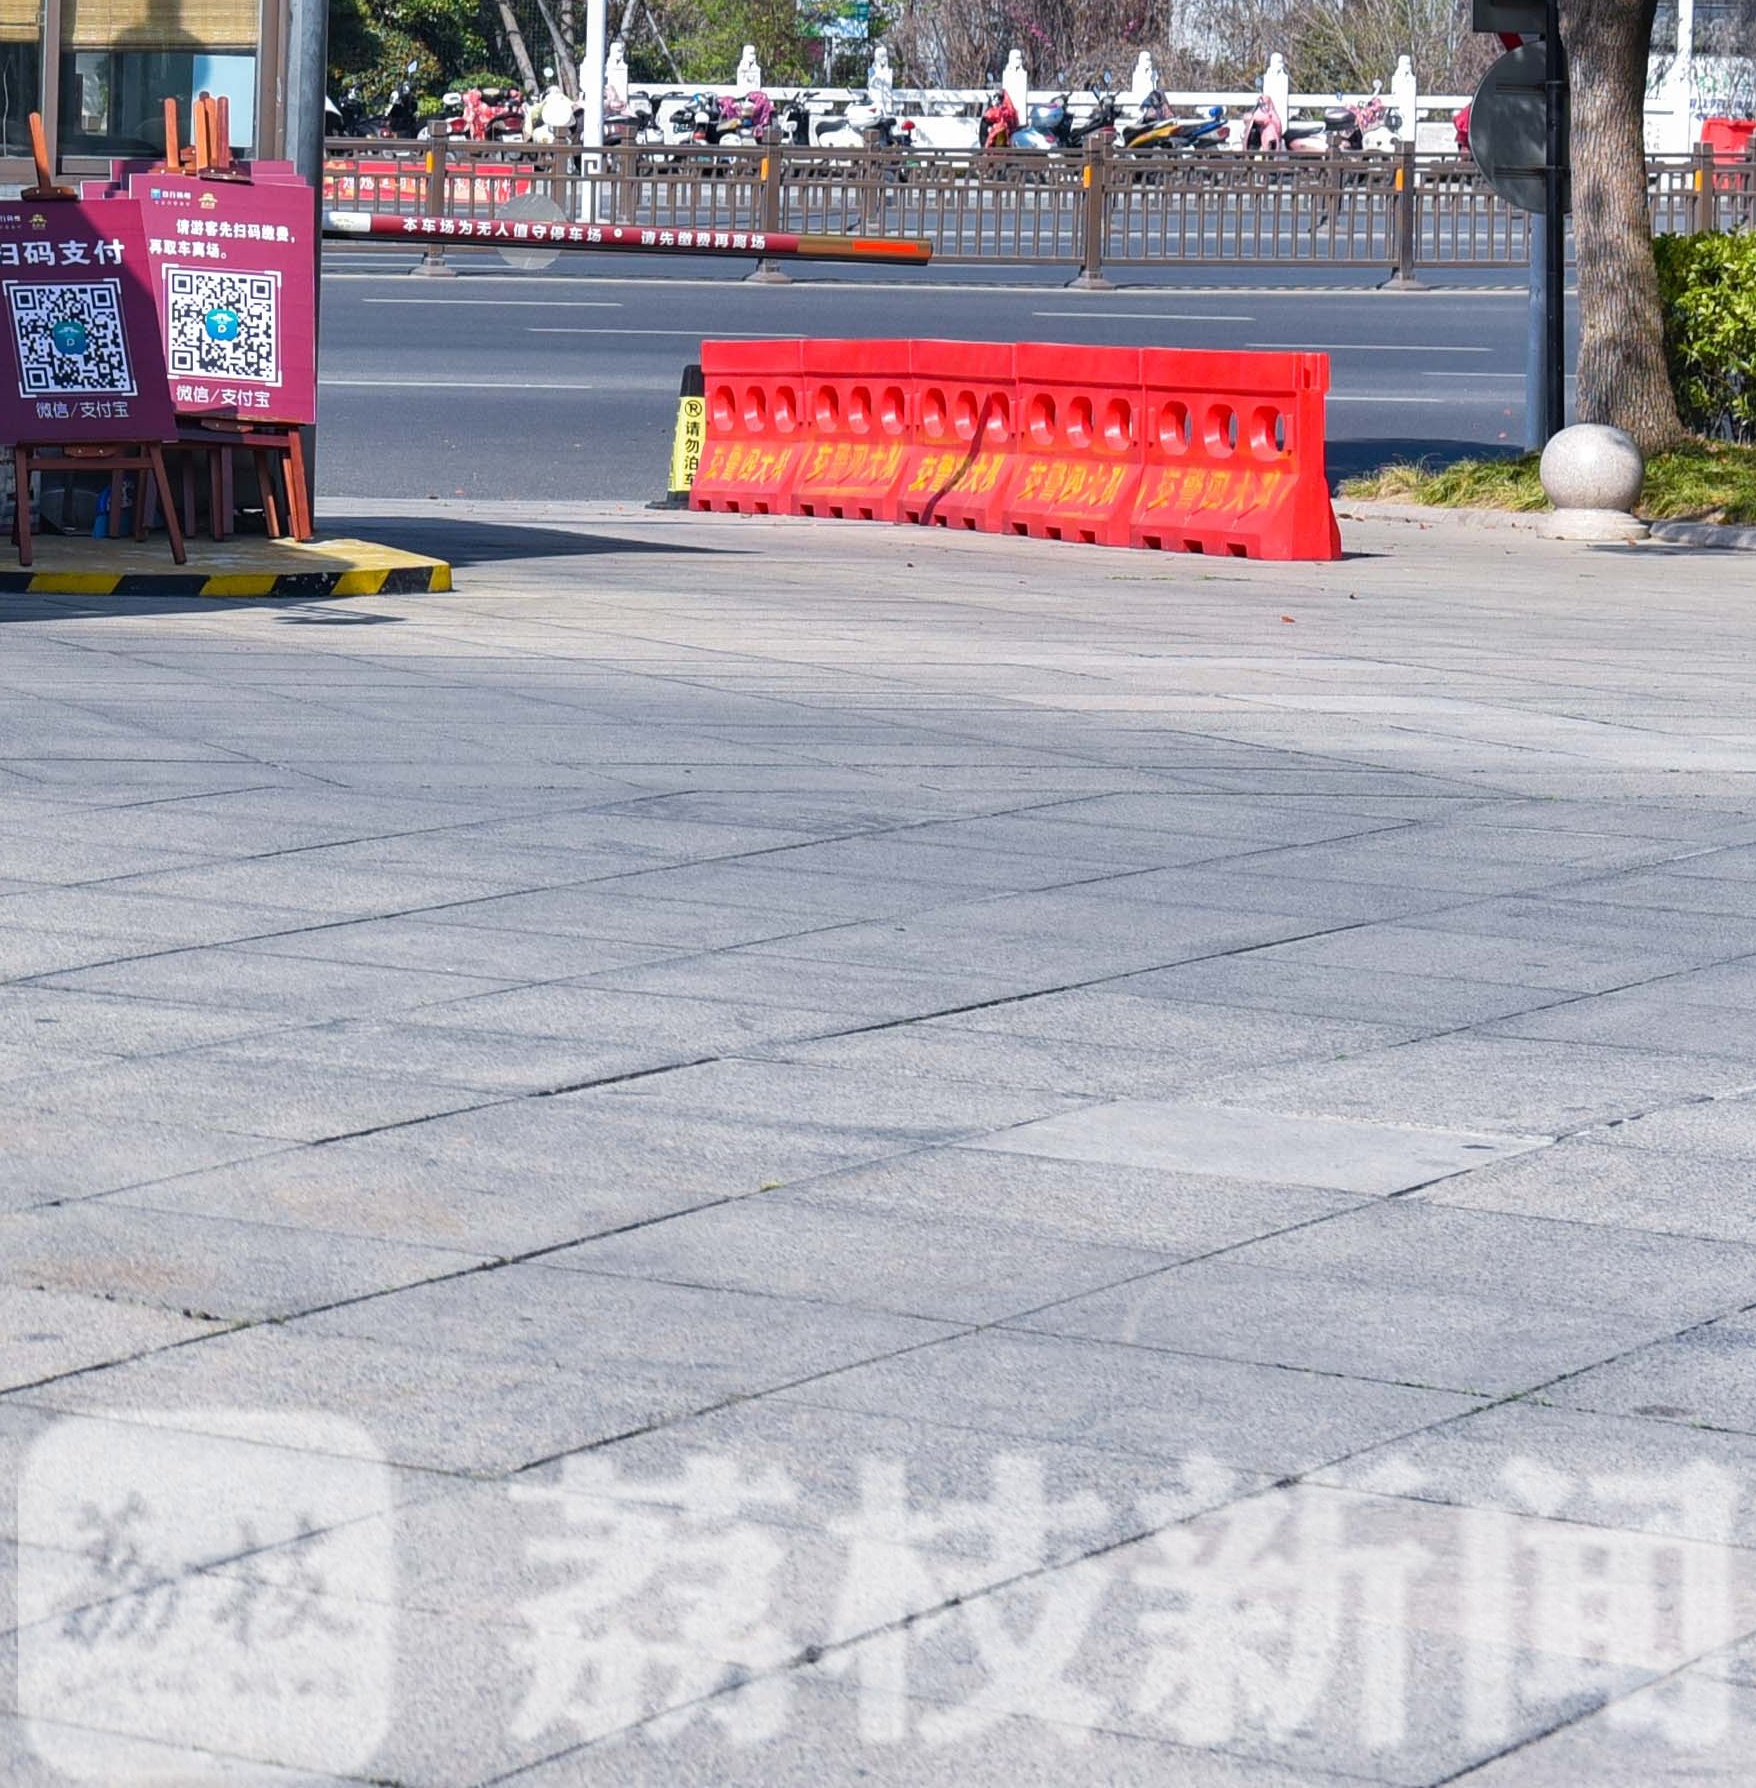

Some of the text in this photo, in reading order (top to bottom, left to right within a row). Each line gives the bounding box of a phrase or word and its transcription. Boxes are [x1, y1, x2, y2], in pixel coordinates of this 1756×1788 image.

[403, 217, 603, 243] 本车场为无人值守停车场
[176, 384, 271, 408] 微信/支付宝
[36, 400, 129, 419] 微信/支付宝
